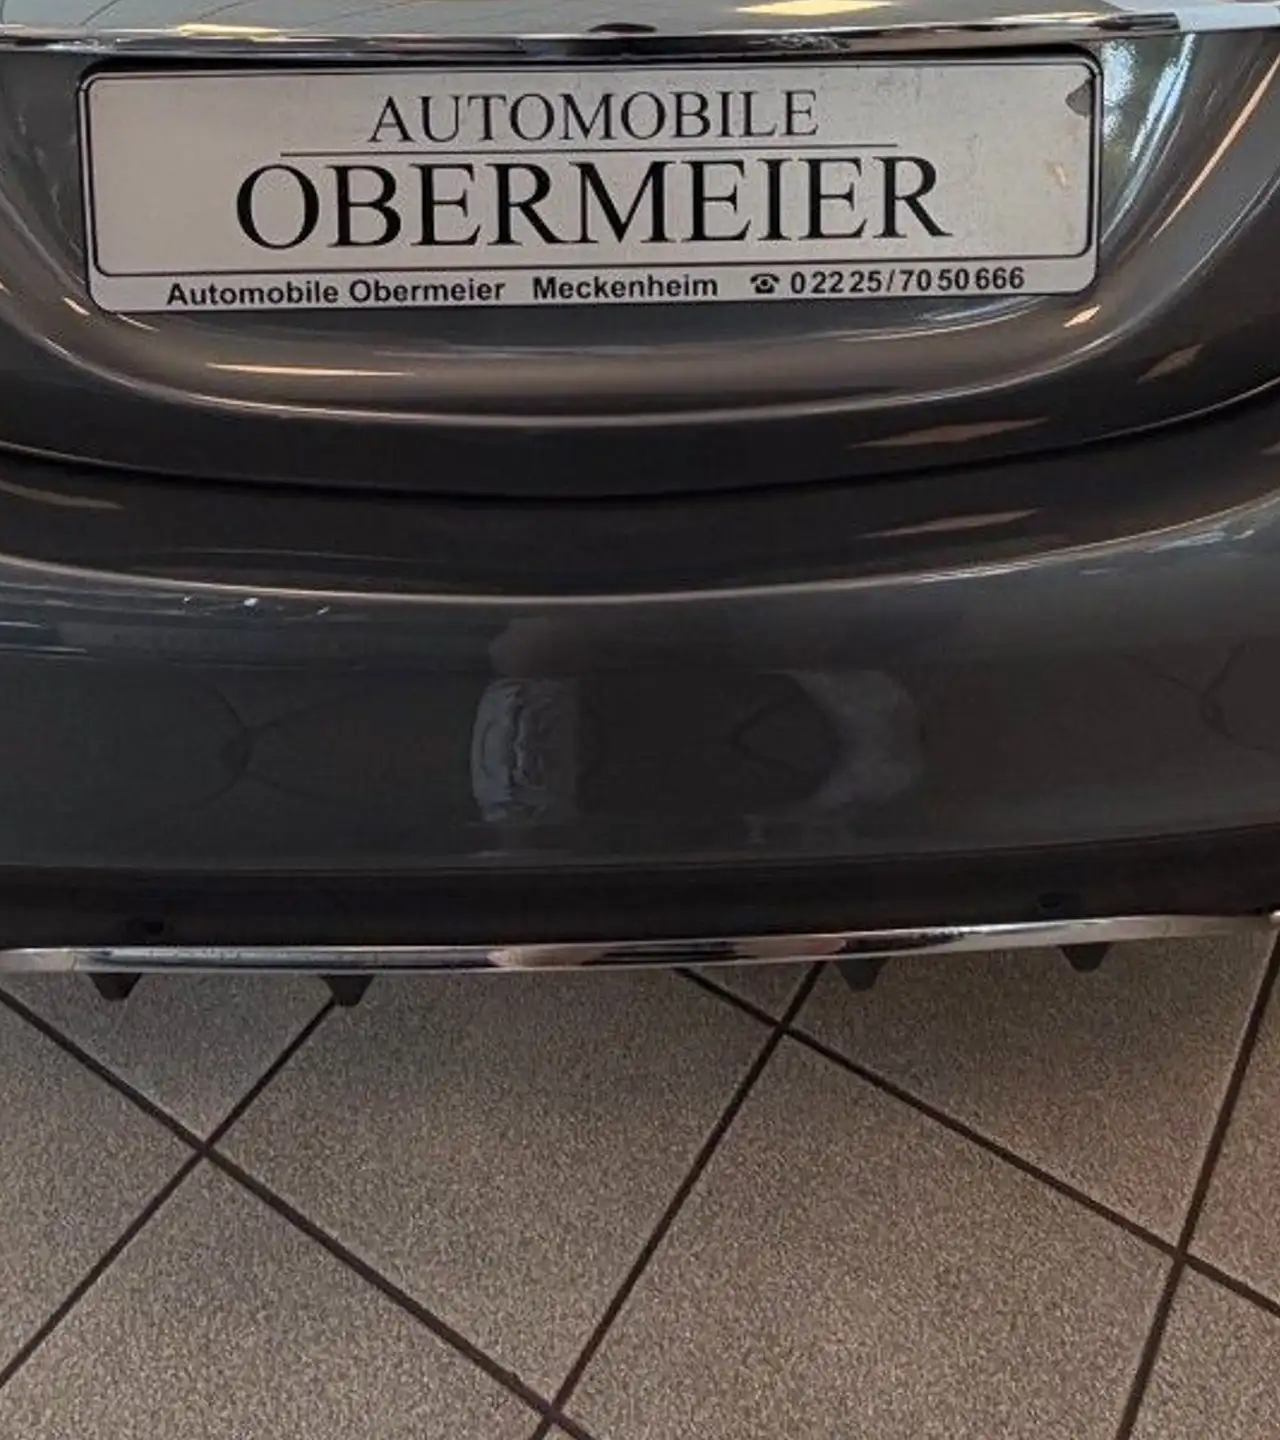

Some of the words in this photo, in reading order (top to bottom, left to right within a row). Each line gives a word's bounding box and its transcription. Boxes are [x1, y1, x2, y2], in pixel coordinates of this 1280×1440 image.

[366, 88, 820, 144] AUTOMOBILE
[235, 155, 954, 250] OBERMEIER
[165, 279, 339, 307] Automobile
[348, 277, 506, 304] Obermeier
[532, 273, 718, 301] Meckenheim
